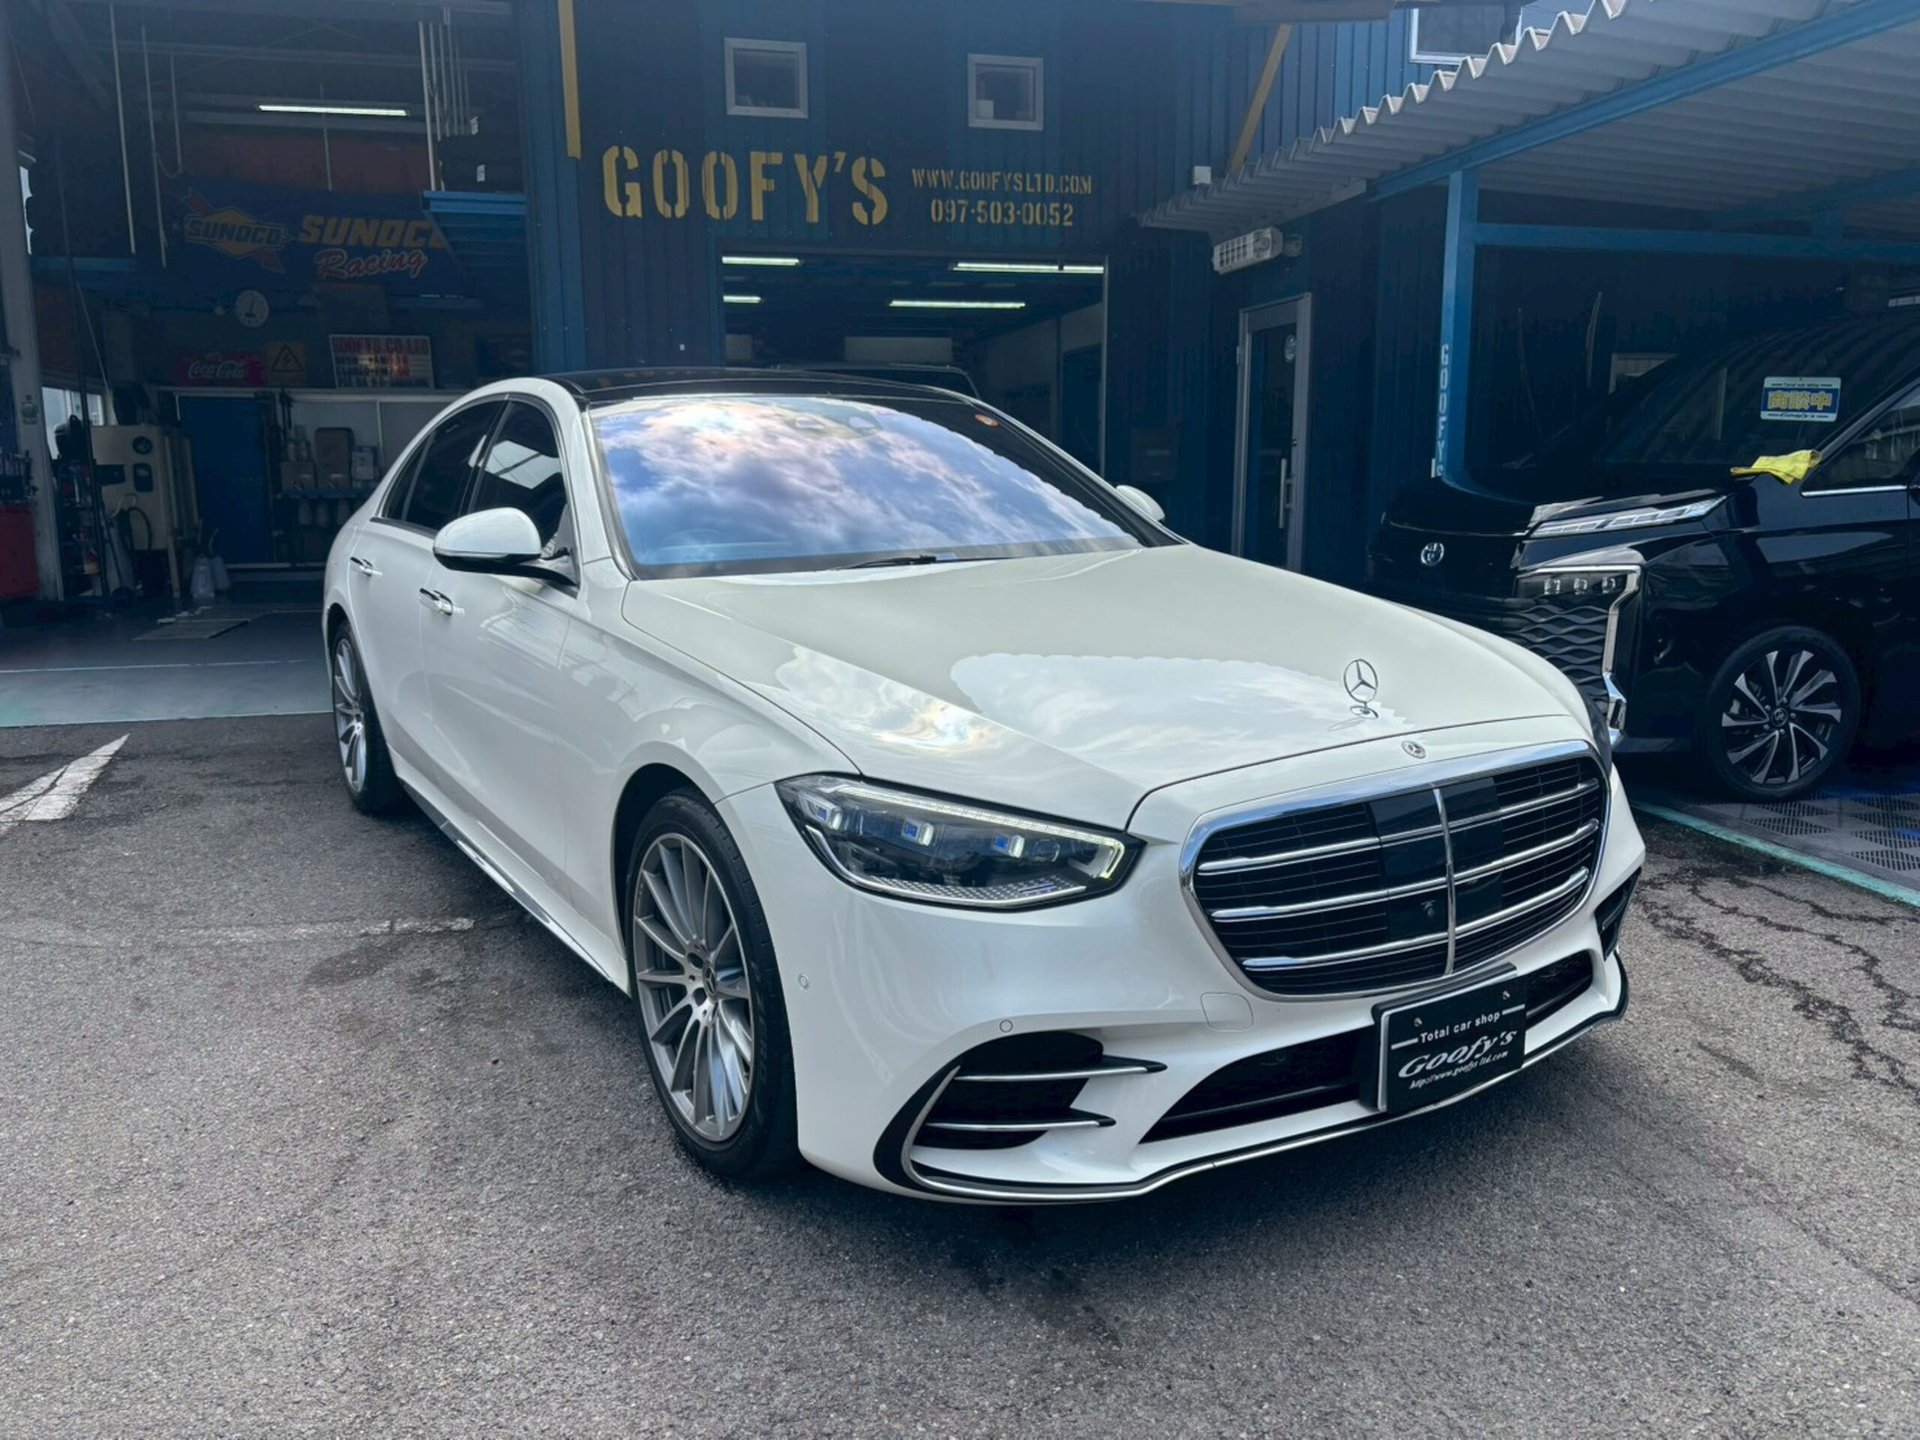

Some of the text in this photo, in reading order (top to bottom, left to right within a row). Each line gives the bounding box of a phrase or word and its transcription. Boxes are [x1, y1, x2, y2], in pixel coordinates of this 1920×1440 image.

[602, 145, 888, 227] GOOFY'S
[911, 167, 1093, 196] WWW.GOOFYSLTD.COM
[186, 218, 284, 246] SUNOCO
[314, 247, 429, 280] Racing
[1421, 1012, 1500, 1043] Total car shop
[1398, 1030, 1518, 1079] Goofy's
